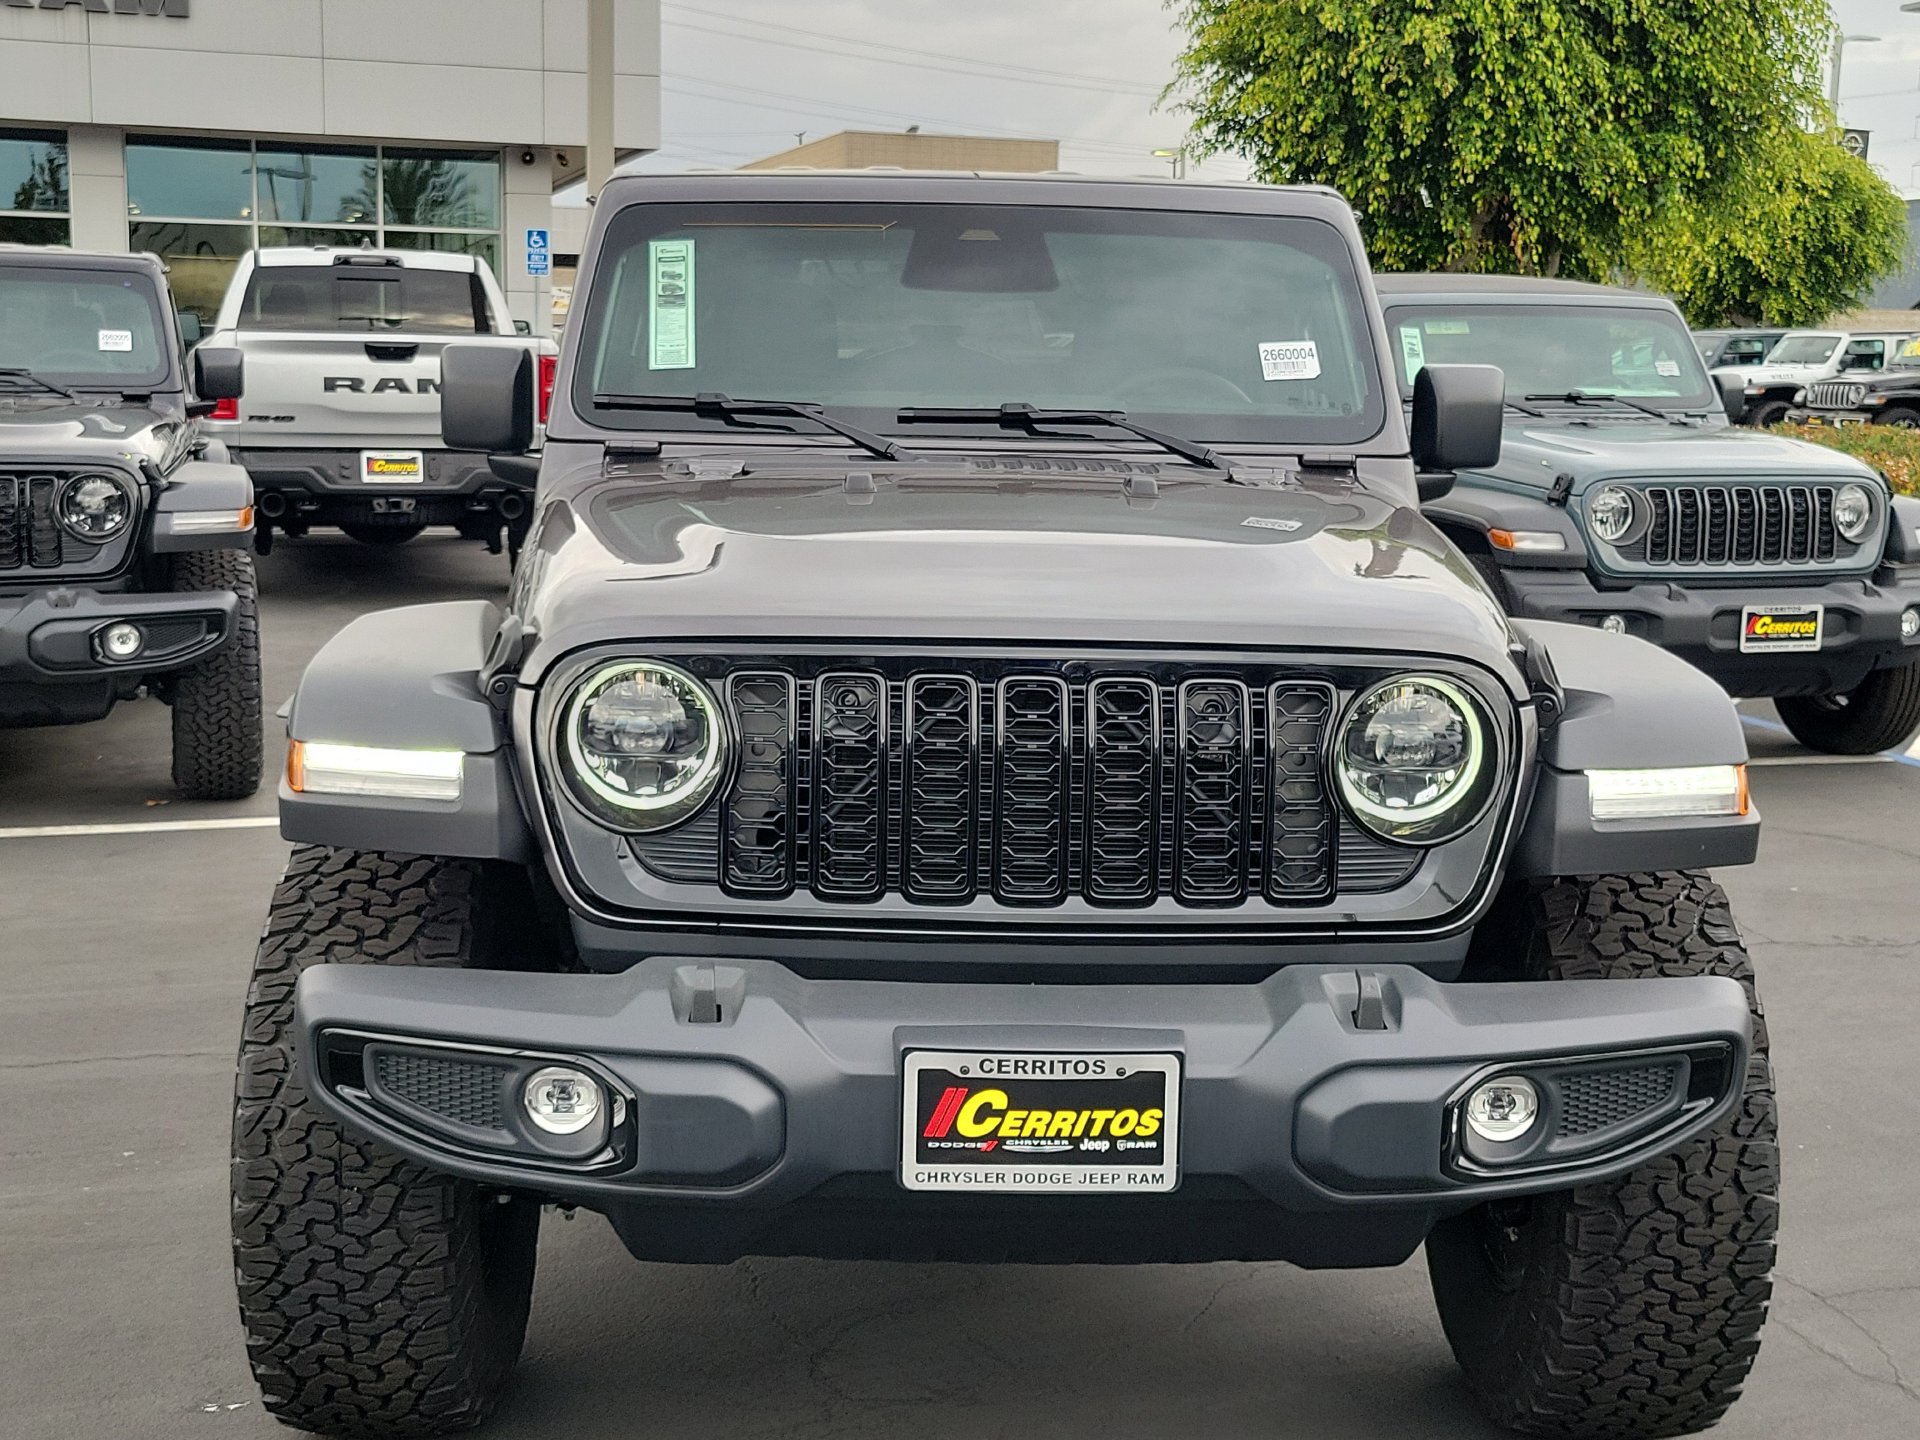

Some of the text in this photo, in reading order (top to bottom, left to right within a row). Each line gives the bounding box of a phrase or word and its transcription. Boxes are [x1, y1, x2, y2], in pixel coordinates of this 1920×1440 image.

[1262, 347, 1315, 361] 2660004
[373, 459, 419, 473] CERRITOS
[1754, 615, 1817, 635] CERRITOS
[978, 1058, 1107, 1076] CERRITOS
[956, 1087, 1164, 1139] CERRITOS
[927, 1140, 985, 1149] DODGE
[1079, 1138, 1111, 1153] Jeep
[1126, 1140, 1158, 1149] RAM
[914, 1171, 1165, 1185] CHRYSLER DODGE JEEP RAM
